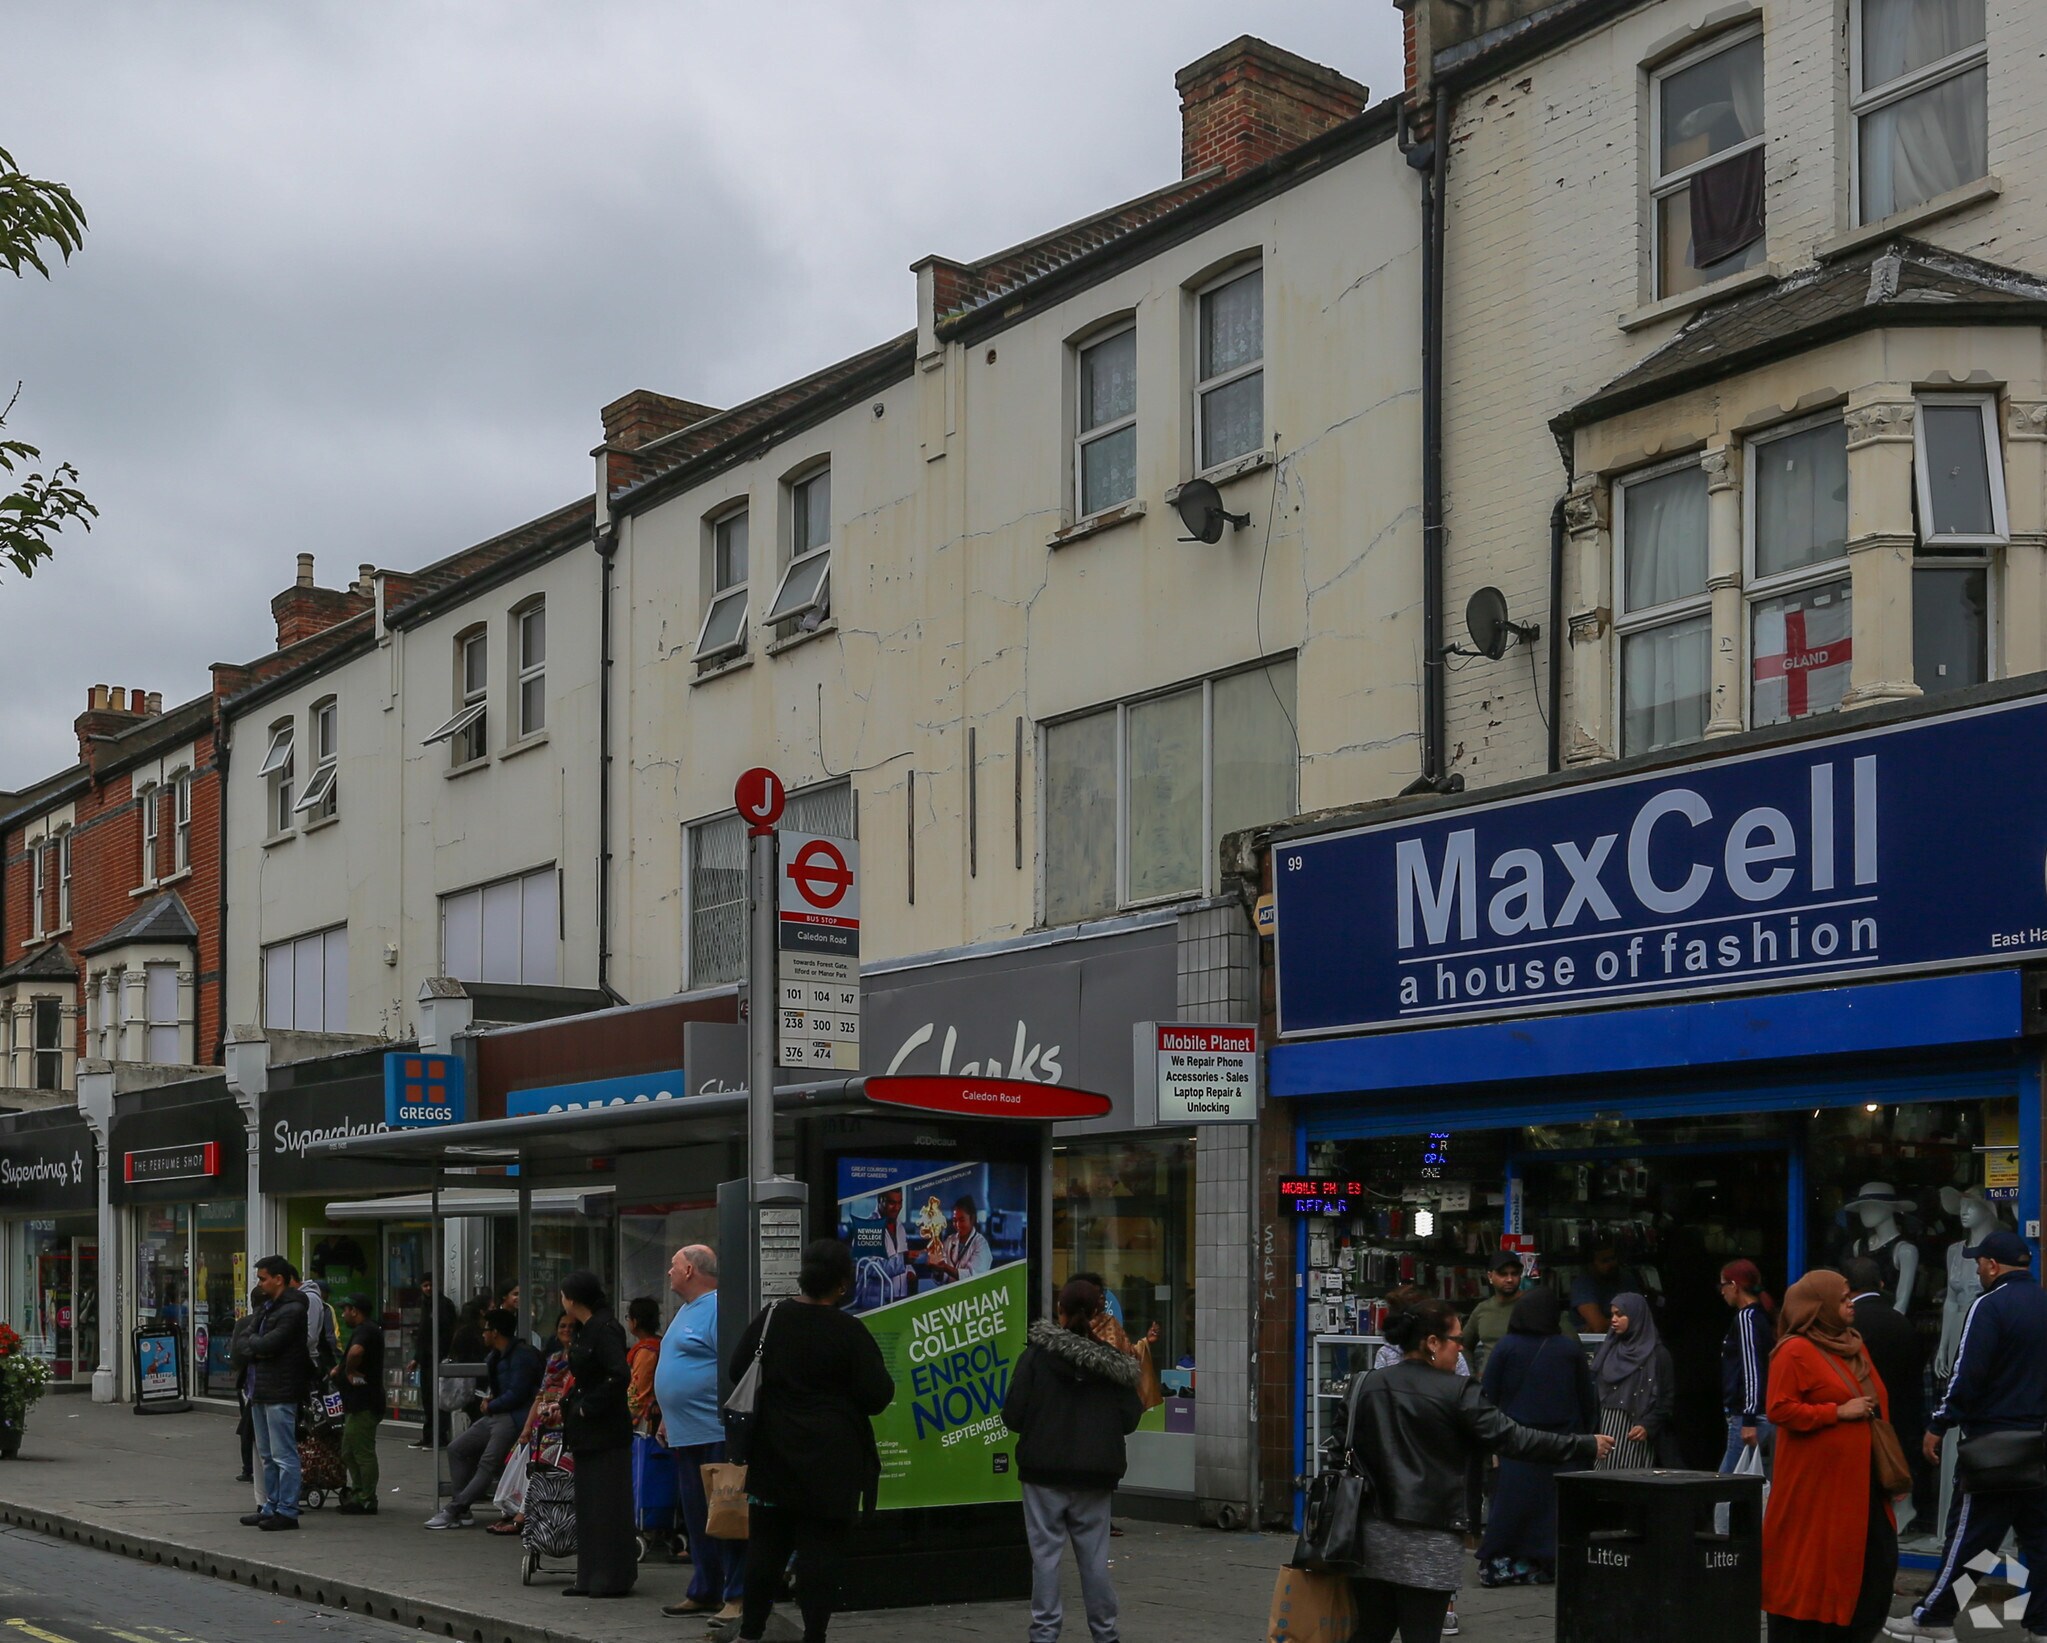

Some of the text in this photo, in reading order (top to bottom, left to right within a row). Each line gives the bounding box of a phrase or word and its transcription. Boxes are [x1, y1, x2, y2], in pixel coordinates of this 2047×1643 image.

[1782, 651, 1829, 670] GLAND
[752, 777, 772, 817] J
[1395, 755, 1877, 949] MaxCell
[1288, 856, 1302, 872] 99
[806, 915, 838, 925] BUS STOP
[1260, 909, 1274, 921] ADT
[797, 931, 847, 945] Caledon Road
[1992, 930, 2025, 948] East
[793, 959, 815, 967] towards
[816, 960, 833, 969] Forest
[1399, 917, 1877, 1004] a house of fashion
[794, 968, 809, 976] Ilford
[818, 969, 834, 978] Manor
[835, 971, 847, 979] Park
[786, 988, 801, 999] 101
[814, 991, 830, 1002] 104
[841, 993, 854, 1004] 147
[785, 1018, 803, 1029] 238
[813, 1020, 831, 1031] 300
[840, 1022, 855, 1033] 325
[1163, 1034, 1250, 1052] Mobile Planet
[785, 1047, 803, 1058] 376
[813, 1049, 831, 1060] 474
[1171, 1056, 1243, 1068] We Repair Phone
[1166, 1071, 1218, 1082] Accessories
[1226, 1072, 1249, 1082] Sales
[962, 1090, 1021, 1104] Caledon Road
[1174, 1087, 1242, 1099] Laptop Repair &
[400, 1106, 452, 1121] GREGGS
[1187, 1102, 1230, 1114] Unlocking
[134, 1154, 203, 1172] THE PERFUME SHOP
[1, 1157, 68, 1188] Superdrug
[1282, 1182, 1317, 1195] MOBILE
[1990, 1188, 2019, 1198] Tel.: 07
[912, 1286, 1010, 1338] NEWHAM
[908, 1311, 1007, 1363] COLLEGE
[911, 1340, 1010, 1397] ENROL
[911, 1368, 1008, 1441] NOW
[983, 1426, 1009, 1446] 2018
[1587, 1547, 1631, 1567] Litter
[1705, 1551, 1740, 1568] Litter
